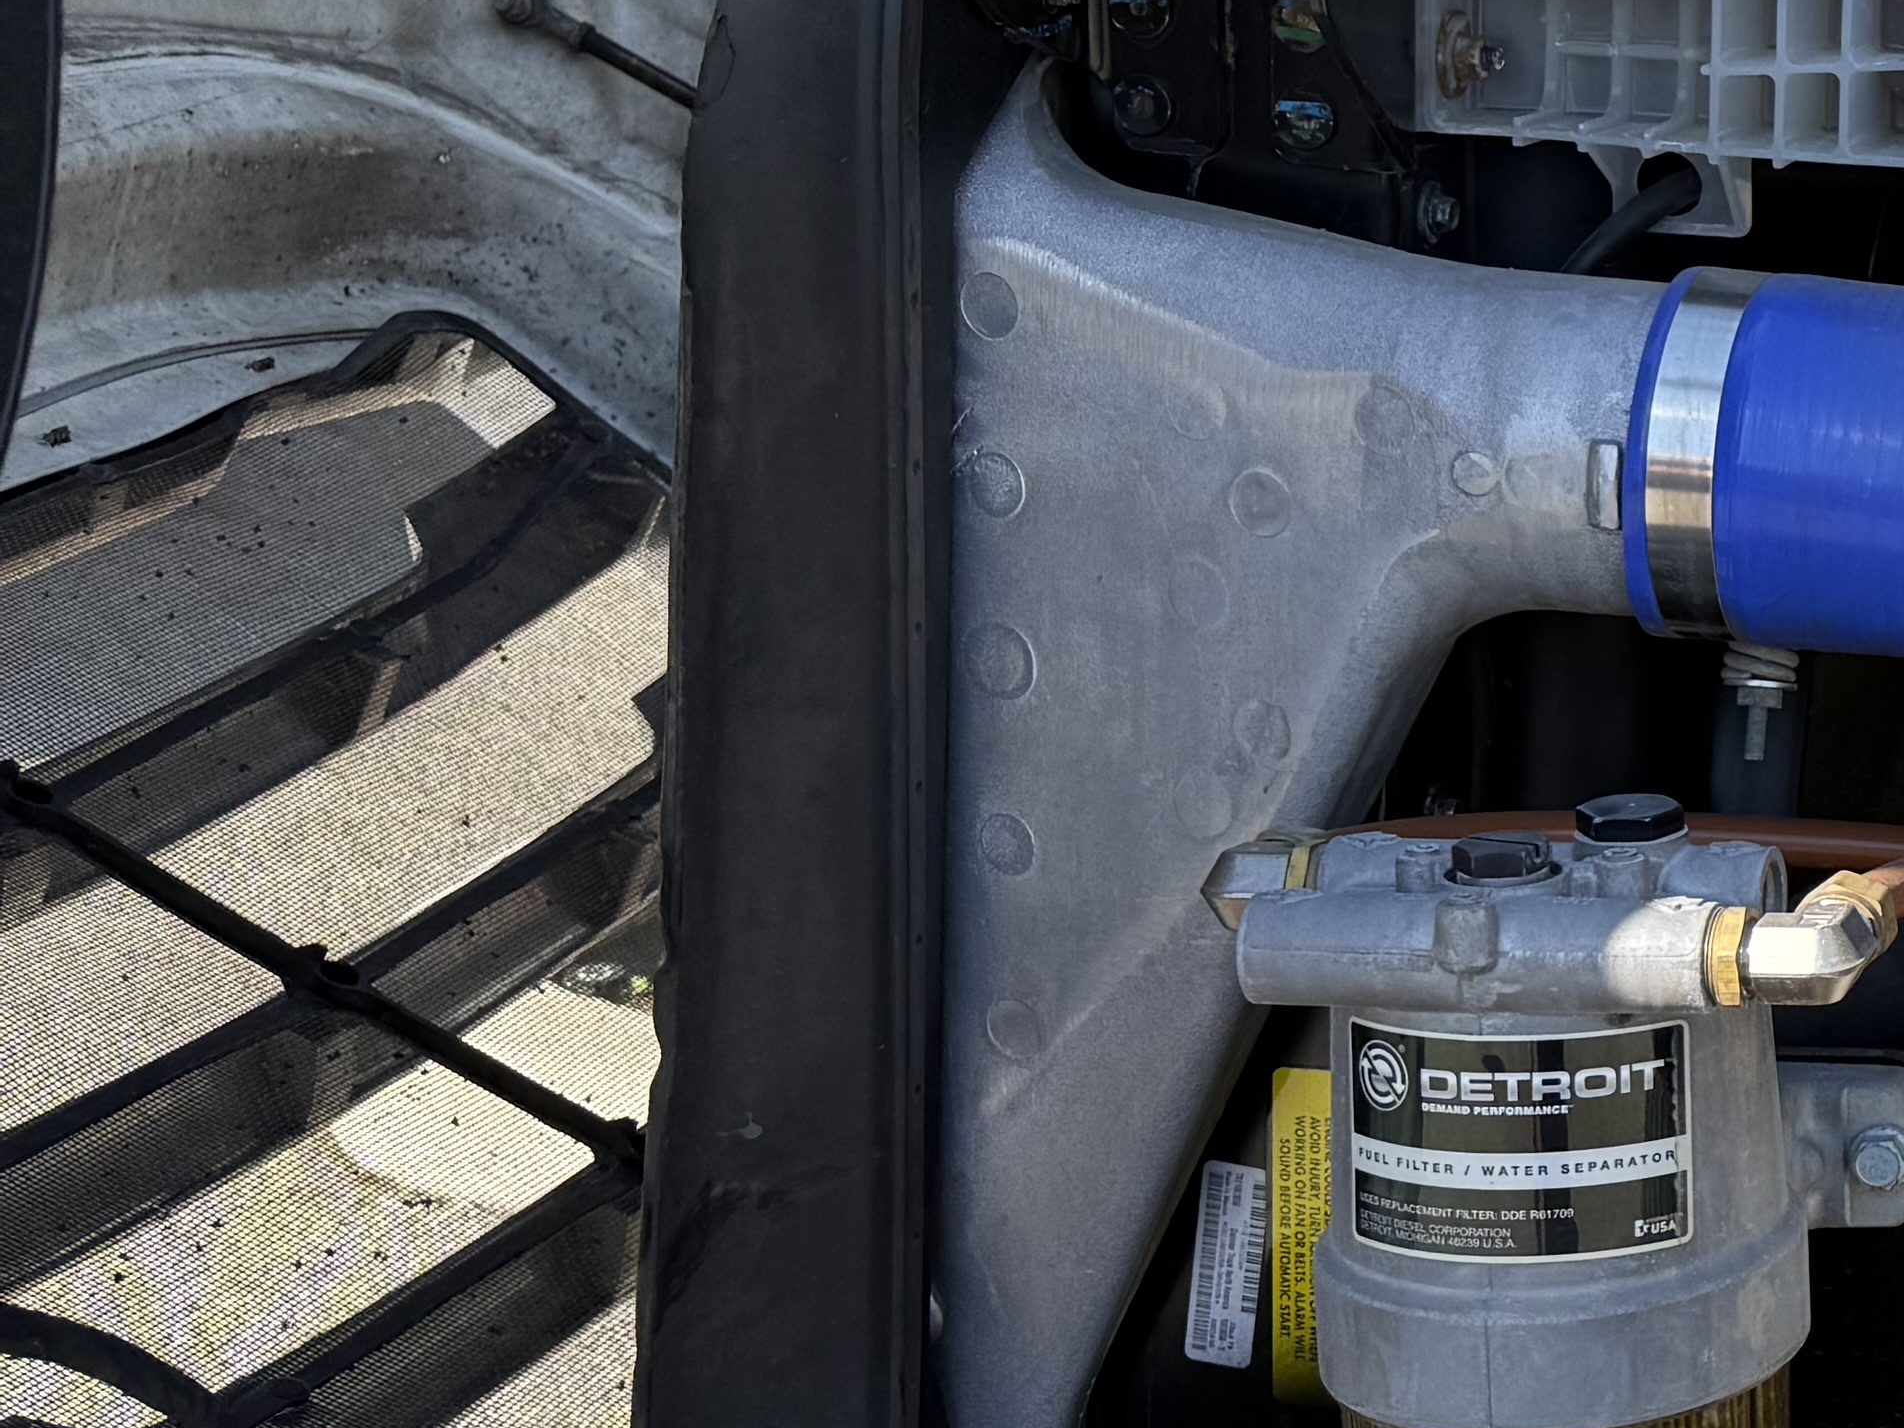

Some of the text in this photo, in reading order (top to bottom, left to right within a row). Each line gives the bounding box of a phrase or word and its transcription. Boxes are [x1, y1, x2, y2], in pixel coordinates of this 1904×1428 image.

[1420, 1059, 1664, 1102] DETROIT
[1421, 1102, 1470, 1115] DEMAND
[1309, 1116, 1321, 1154] AVOID
[1279, 1138, 1291, 1182] SOUND
[1308, 1158, 1321, 1202] INJURY,
[1358, 1147, 1389, 1165] FUEL
[1396, 1156, 1454, 1175] FILTER
[1482, 1164, 1548, 1177] WATER
[1561, 1149, 1676, 1174] SEPARATOR
[1279, 1186, 1291, 1229] BEFORE
[1309, 1206, 1321, 1237] TURN
[1380, 1197, 1453, 1219] REPLACEMENT
[1294, 1115, 1307, 1360] WORKING ON FAN OR BELTS. ALARM WILL
[1428, 1225, 1511, 1238] CORPORATION
[1279, 1232, 1292, 1300] AUTOMATIC
